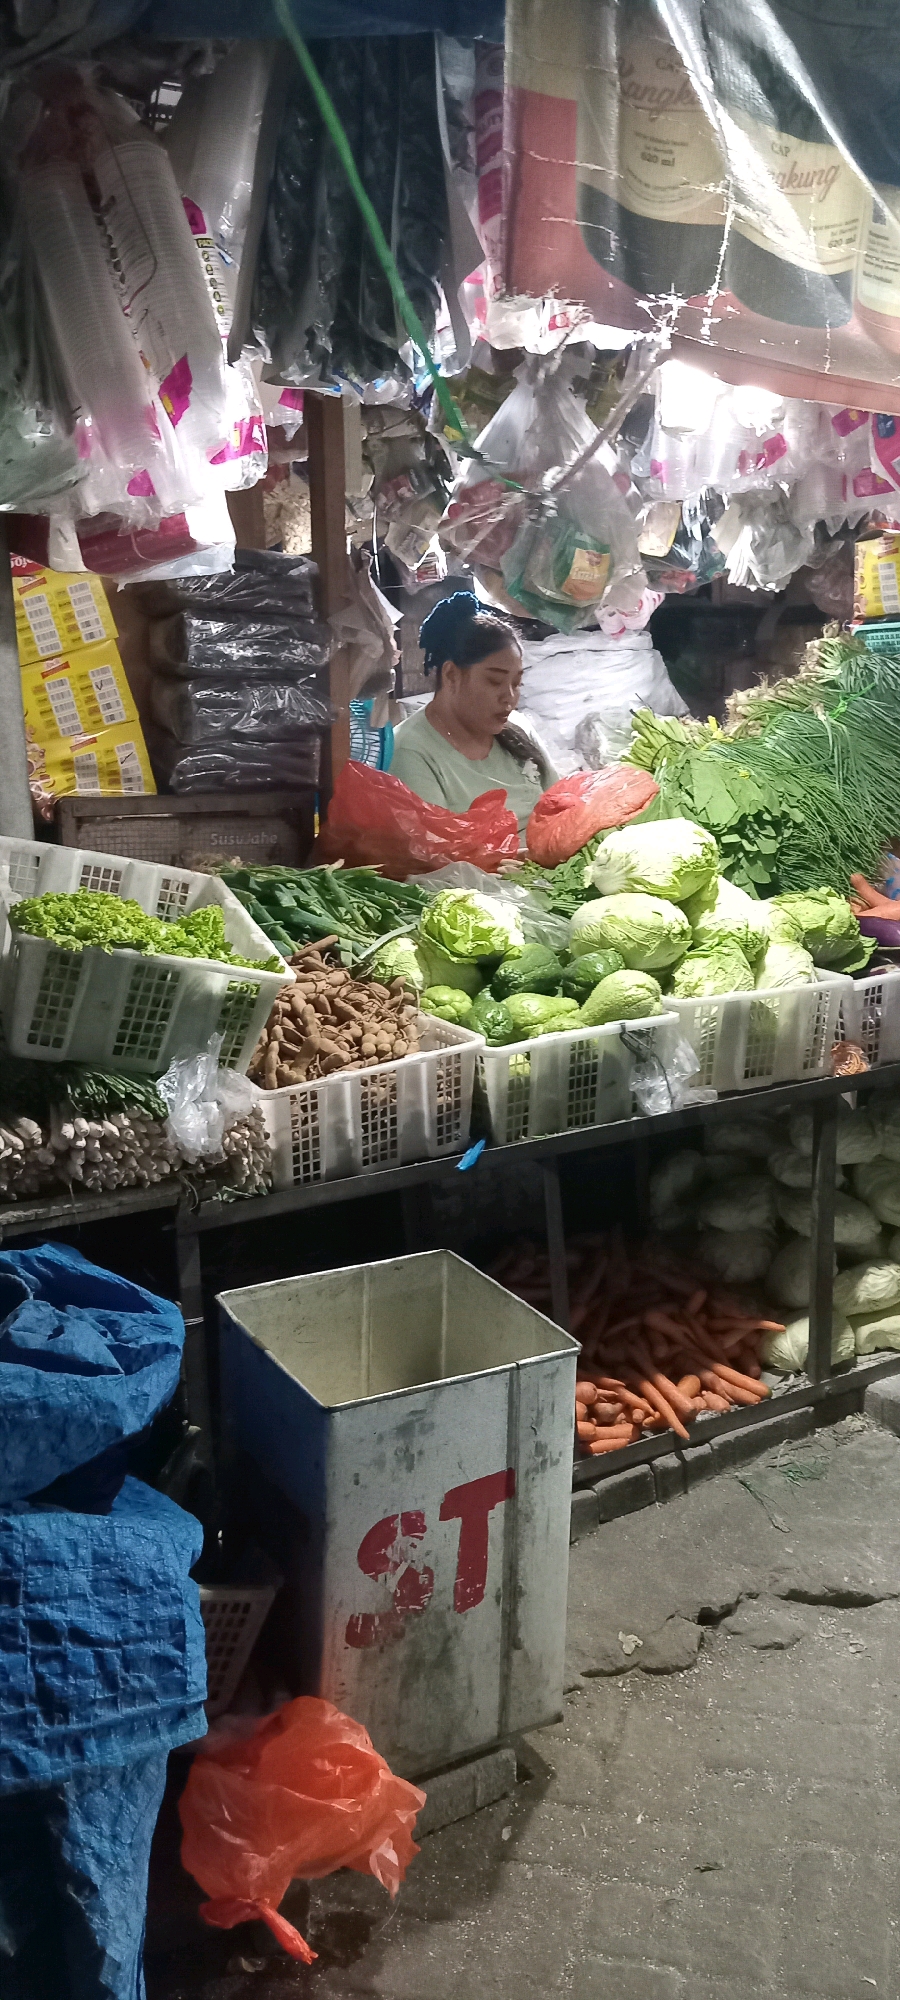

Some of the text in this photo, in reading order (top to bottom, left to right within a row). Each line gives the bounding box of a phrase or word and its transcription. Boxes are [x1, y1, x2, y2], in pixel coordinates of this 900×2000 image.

[770, 142, 791, 157] CAP
[828, 238, 844, 249] 620
[344, 1467, 516, 1649] ST
